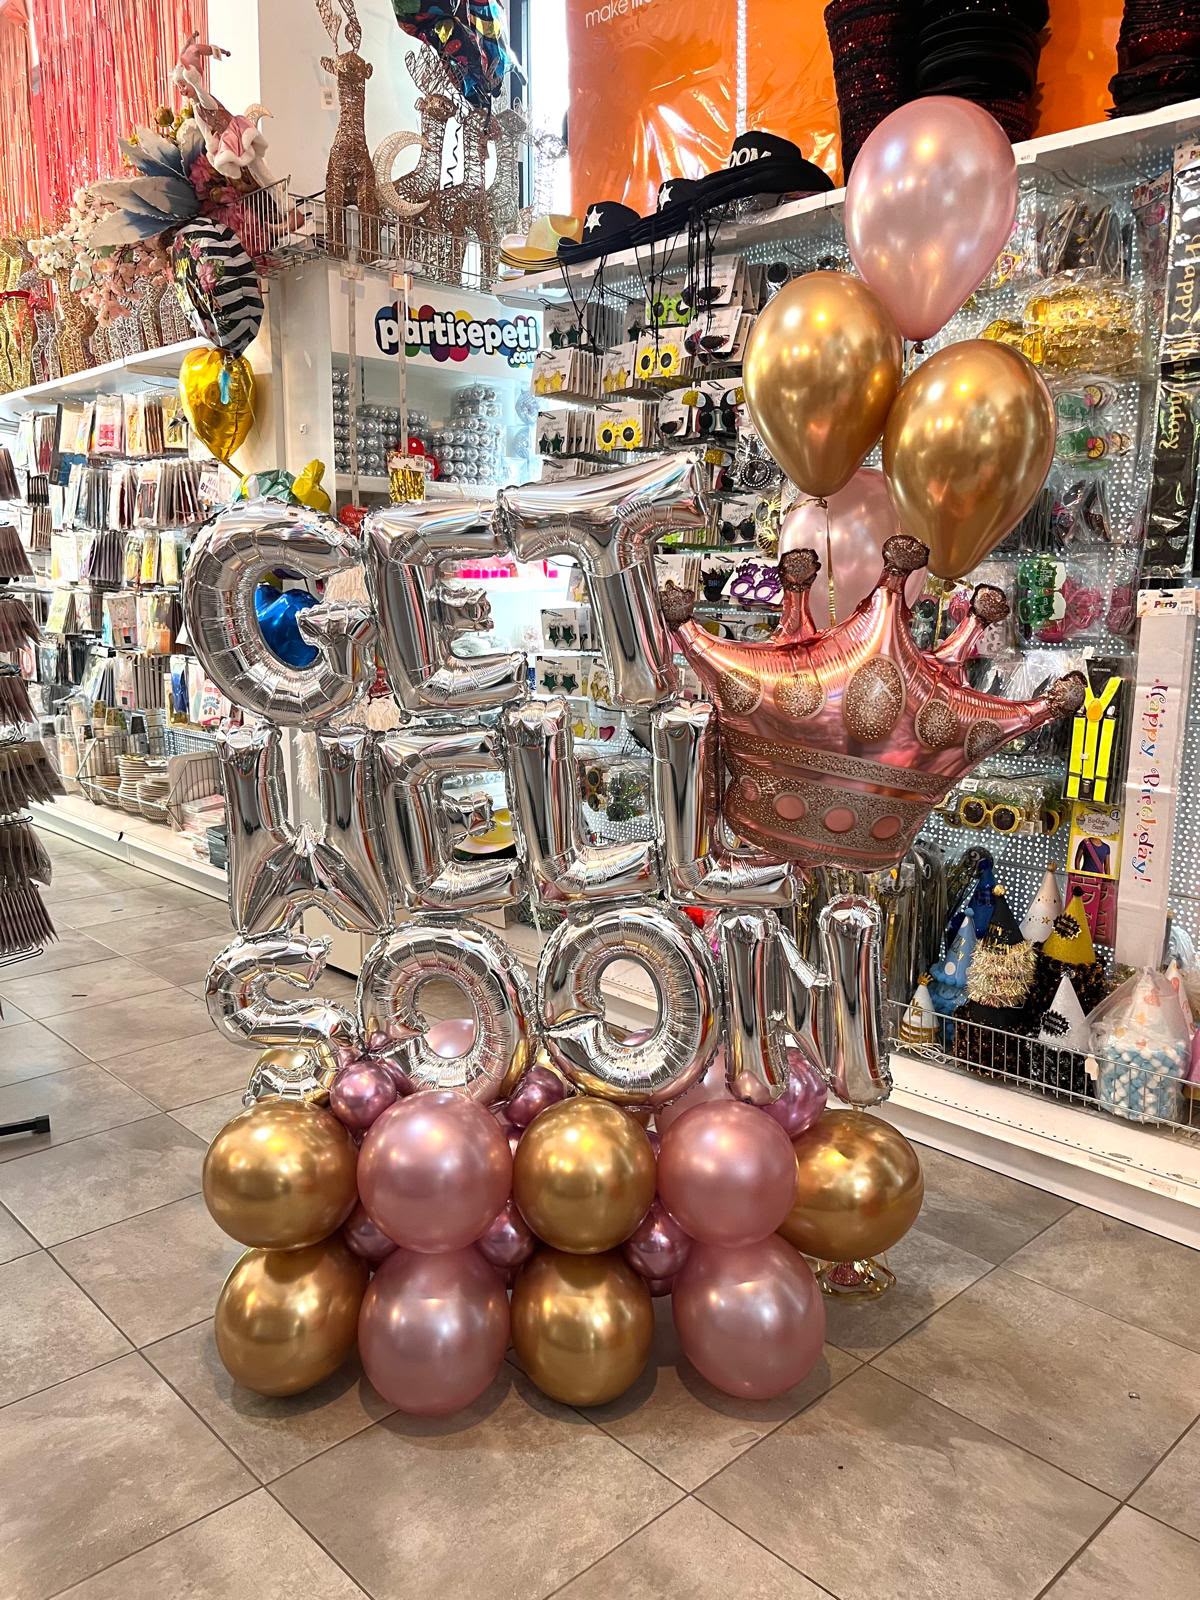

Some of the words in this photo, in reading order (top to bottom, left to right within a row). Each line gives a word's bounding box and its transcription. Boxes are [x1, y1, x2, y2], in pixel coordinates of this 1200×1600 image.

[585, 0, 629, 29] make
[377, 311, 539, 355] partisepeti
[182, 452, 708, 728] GET
[1154, 600, 1178, 609] Party
[215, 698, 800, 937] WELL
[206, 894, 892, 1108] SOON
